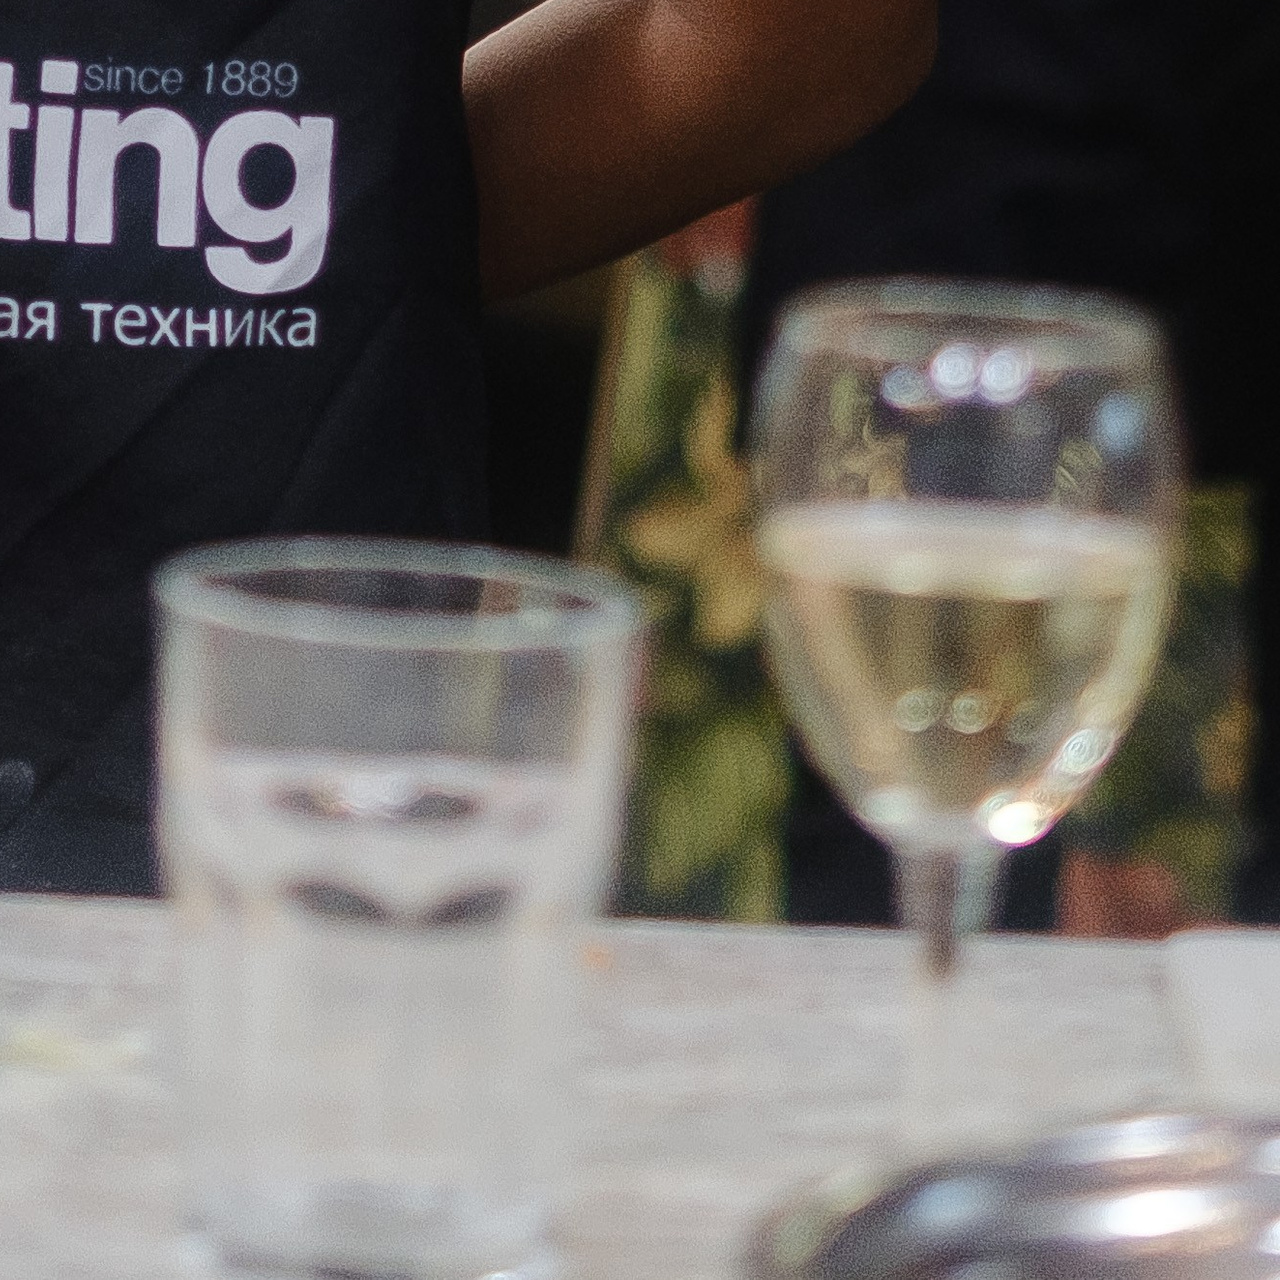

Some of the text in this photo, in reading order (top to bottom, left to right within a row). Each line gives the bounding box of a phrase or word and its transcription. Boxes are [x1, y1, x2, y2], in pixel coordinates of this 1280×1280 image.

[84, 56, 299, 98] since 1889
[80, 299, 318, 348] техника
